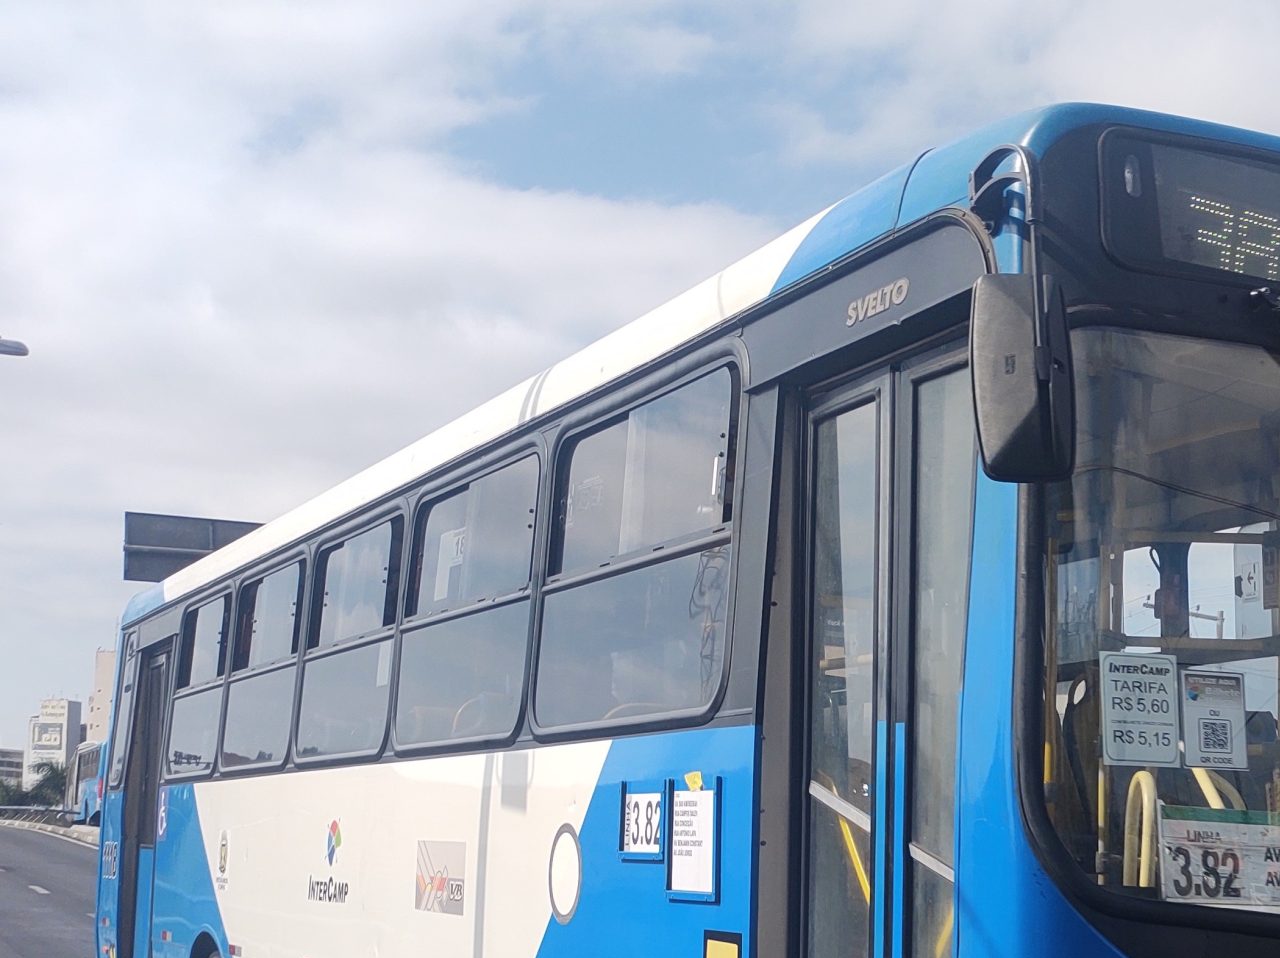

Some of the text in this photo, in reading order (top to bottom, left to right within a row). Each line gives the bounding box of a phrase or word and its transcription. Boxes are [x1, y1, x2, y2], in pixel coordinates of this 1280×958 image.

[846, 277, 910, 327] SVELTO
[1111, 679, 1168, 695] TARIFA
[1136, 698, 1170, 715] 5,60
[1137, 731, 1171, 747] 5,15
[1200, 756, 1233, 765] QR CODE
[624, 800, 632, 846] LINHA
[631, 800, 661, 846] 3.82
[1166, 845, 1242, 899] 3.82
